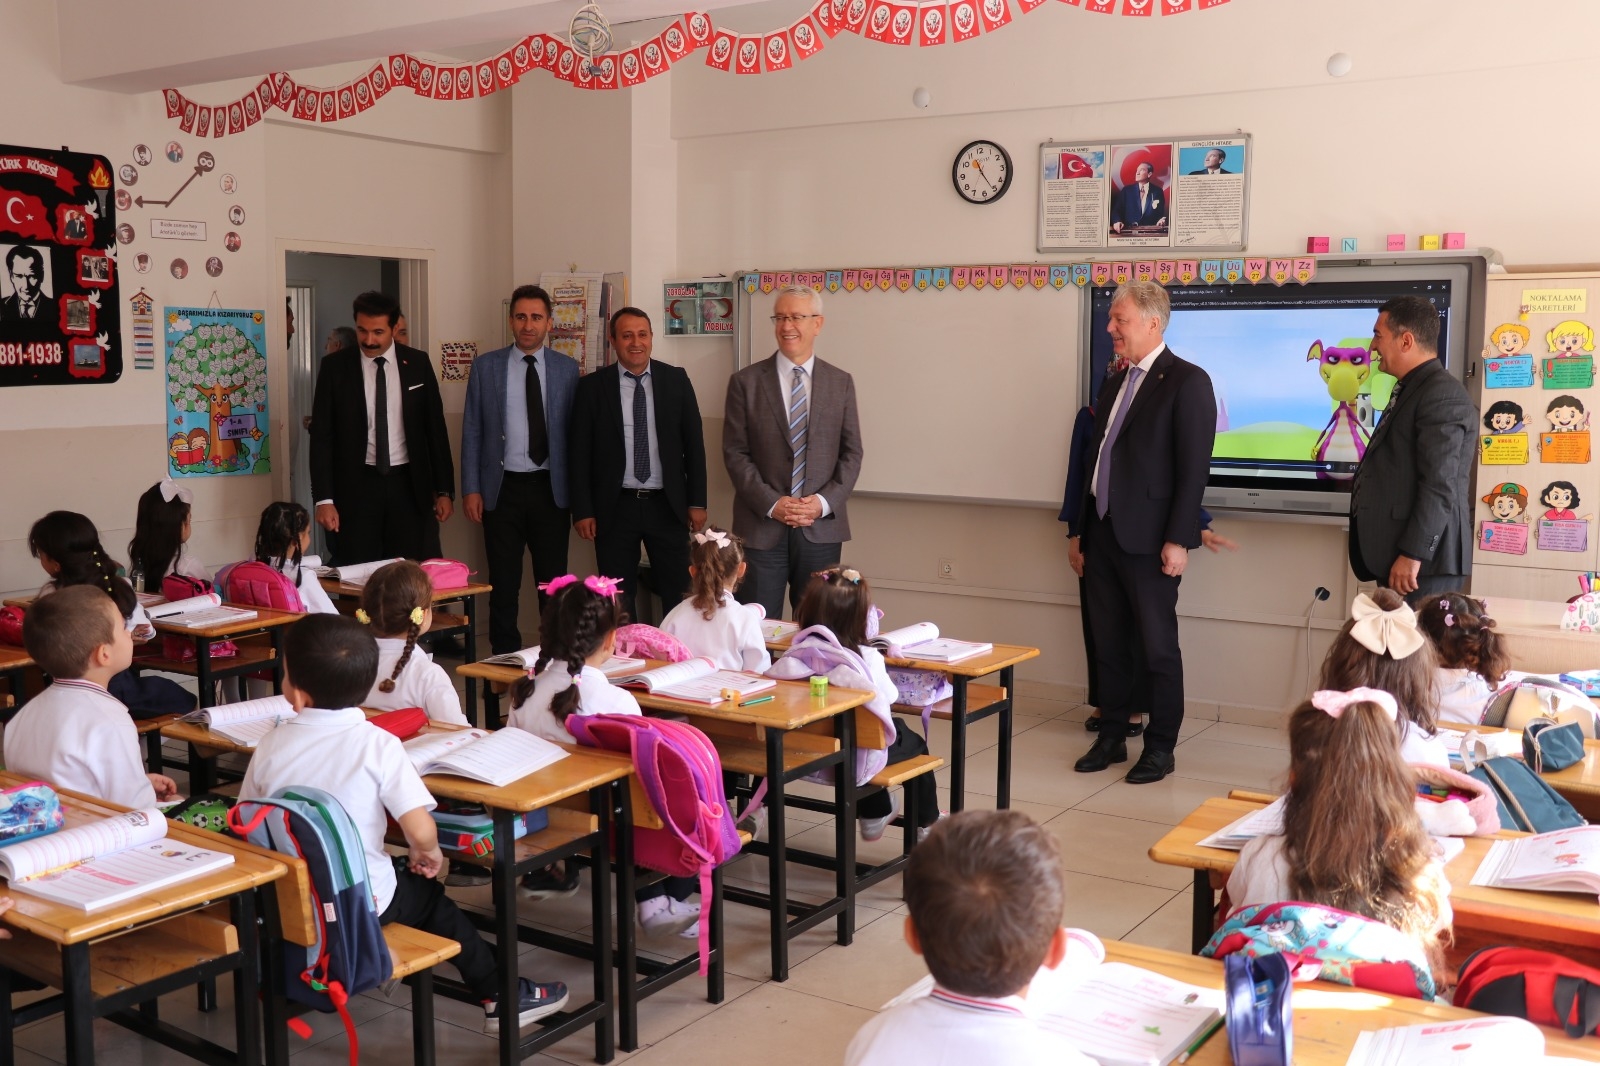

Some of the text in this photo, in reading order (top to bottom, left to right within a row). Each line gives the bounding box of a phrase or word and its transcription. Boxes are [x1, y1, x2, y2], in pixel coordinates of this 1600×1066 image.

[993, 19, 1005, 29] ATA
[676, 50, 688, 58] ATA
[806, 47, 817, 56] ATA
[27, 159, 58, 177] KÖŞESİ
[1345, 240, 1354, 251] N
[1097, 266, 1107, 274] Pp
[1160, 263, 1171, 273] Şş
[1205, 263, 1217, 271] Uu
[1227, 261, 1240, 270] Üü
[1276, 261, 1288, 271] Yy
[958, 270, 964, 278] Jj
[1053, 268, 1066, 277] Oo
[1075, 266, 1087, 275] Öö
[798, 275, 807, 283] Çç
[863, 272, 873, 280] Gg
[881, 271, 890, 280] Ğğ
[178, 310, 216, 318] BAŞARIMIZLA
[705, 321, 733, 330] MOBİLYA
[228, 428, 248, 437] SINIFI
